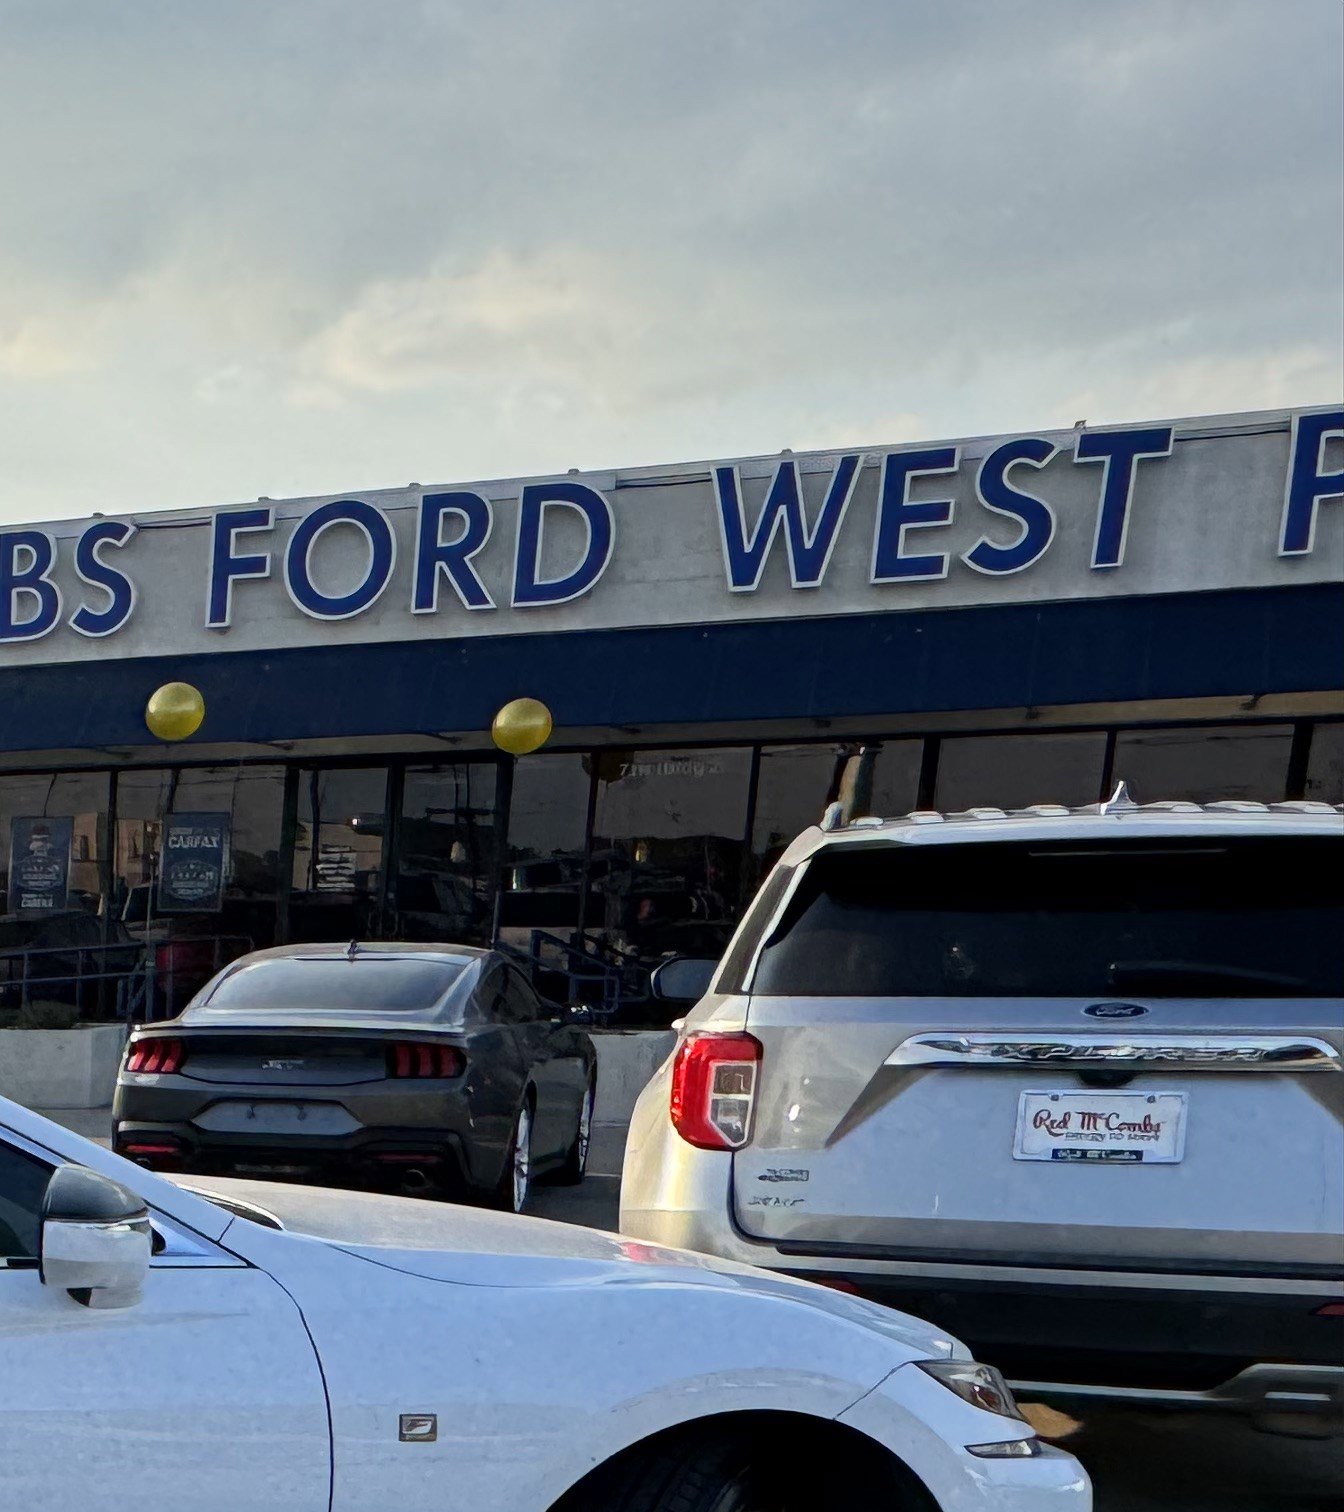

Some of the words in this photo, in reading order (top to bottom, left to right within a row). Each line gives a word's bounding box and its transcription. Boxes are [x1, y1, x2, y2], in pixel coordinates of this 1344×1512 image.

[204, 482, 617, 629] FORD
[712, 427, 1175, 593] WEST
[1033, 1108, 1072, 1137] Red
